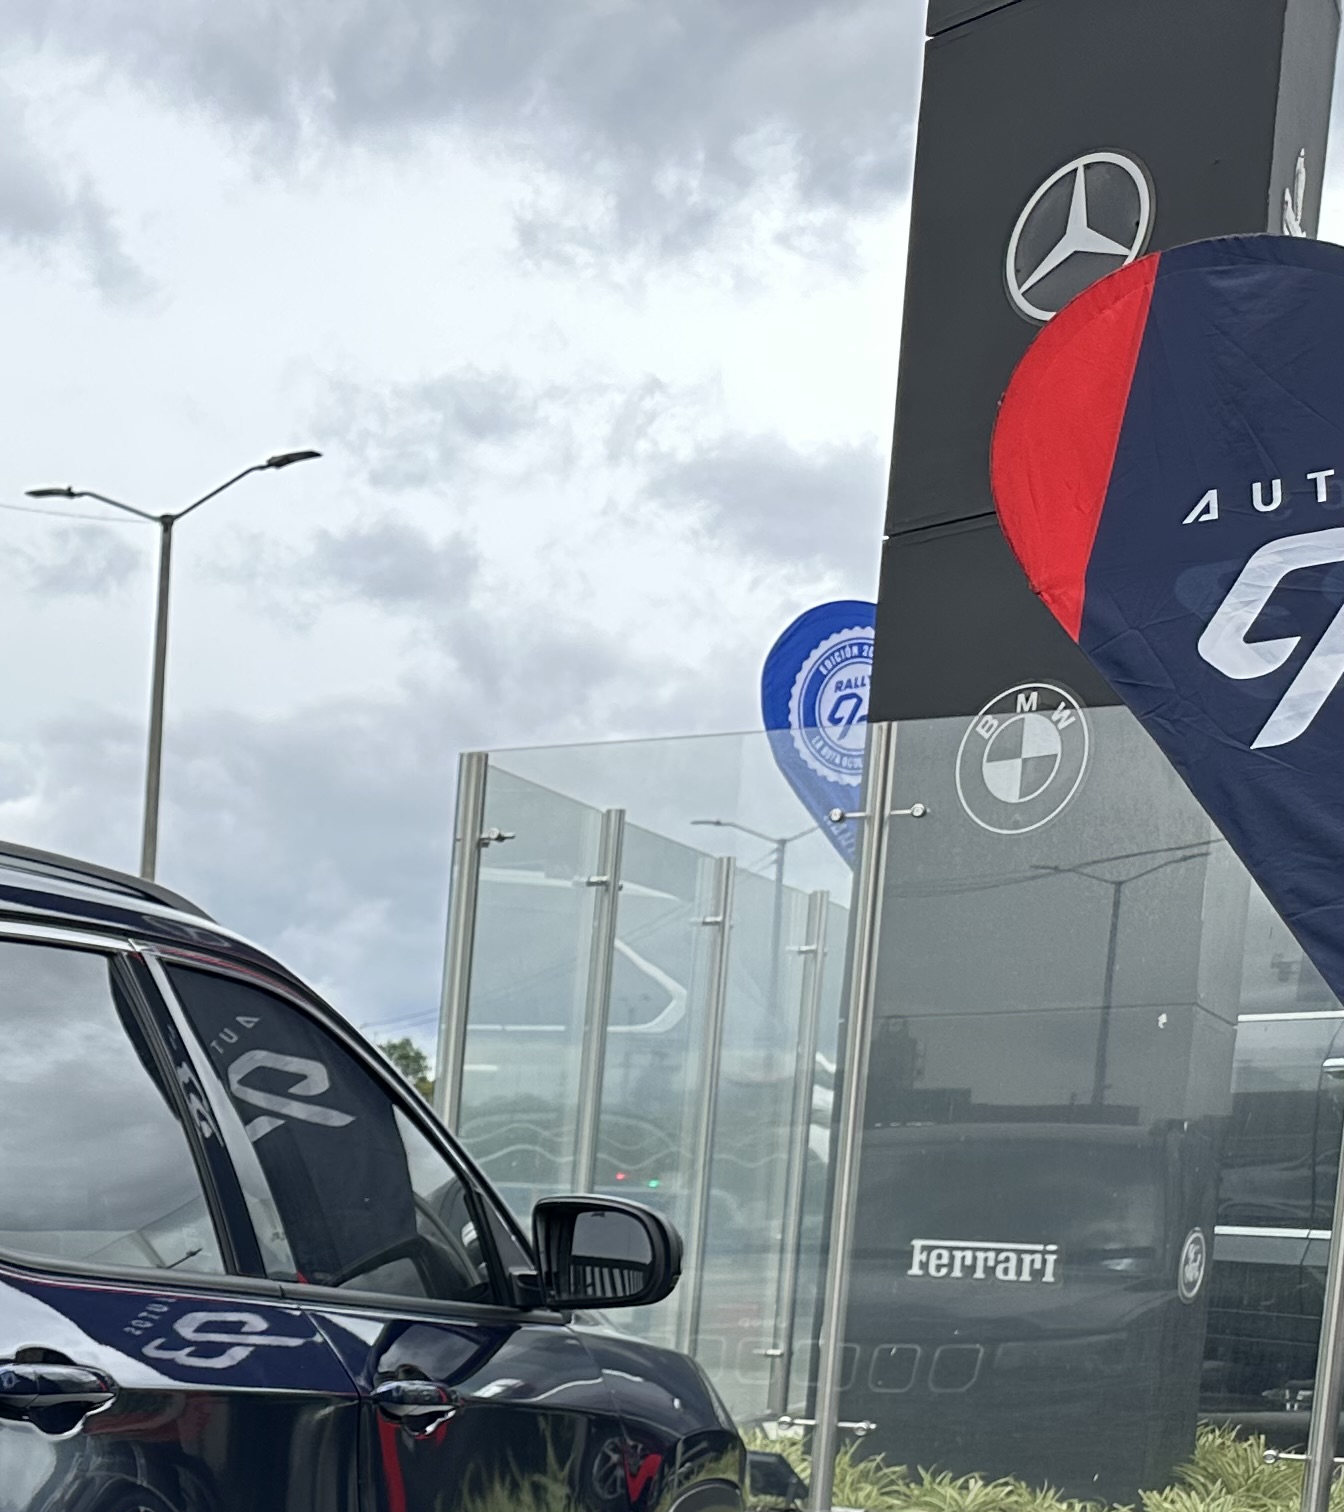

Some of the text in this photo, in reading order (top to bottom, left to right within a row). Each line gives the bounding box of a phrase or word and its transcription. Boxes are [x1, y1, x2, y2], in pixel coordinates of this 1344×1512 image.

[818, 644, 860, 676] EDICIÓN
[834, 675, 871, 694] RALL
[975, 691, 1076, 740] BMW
[907, 1239, 1058, 1283] Ferrari
